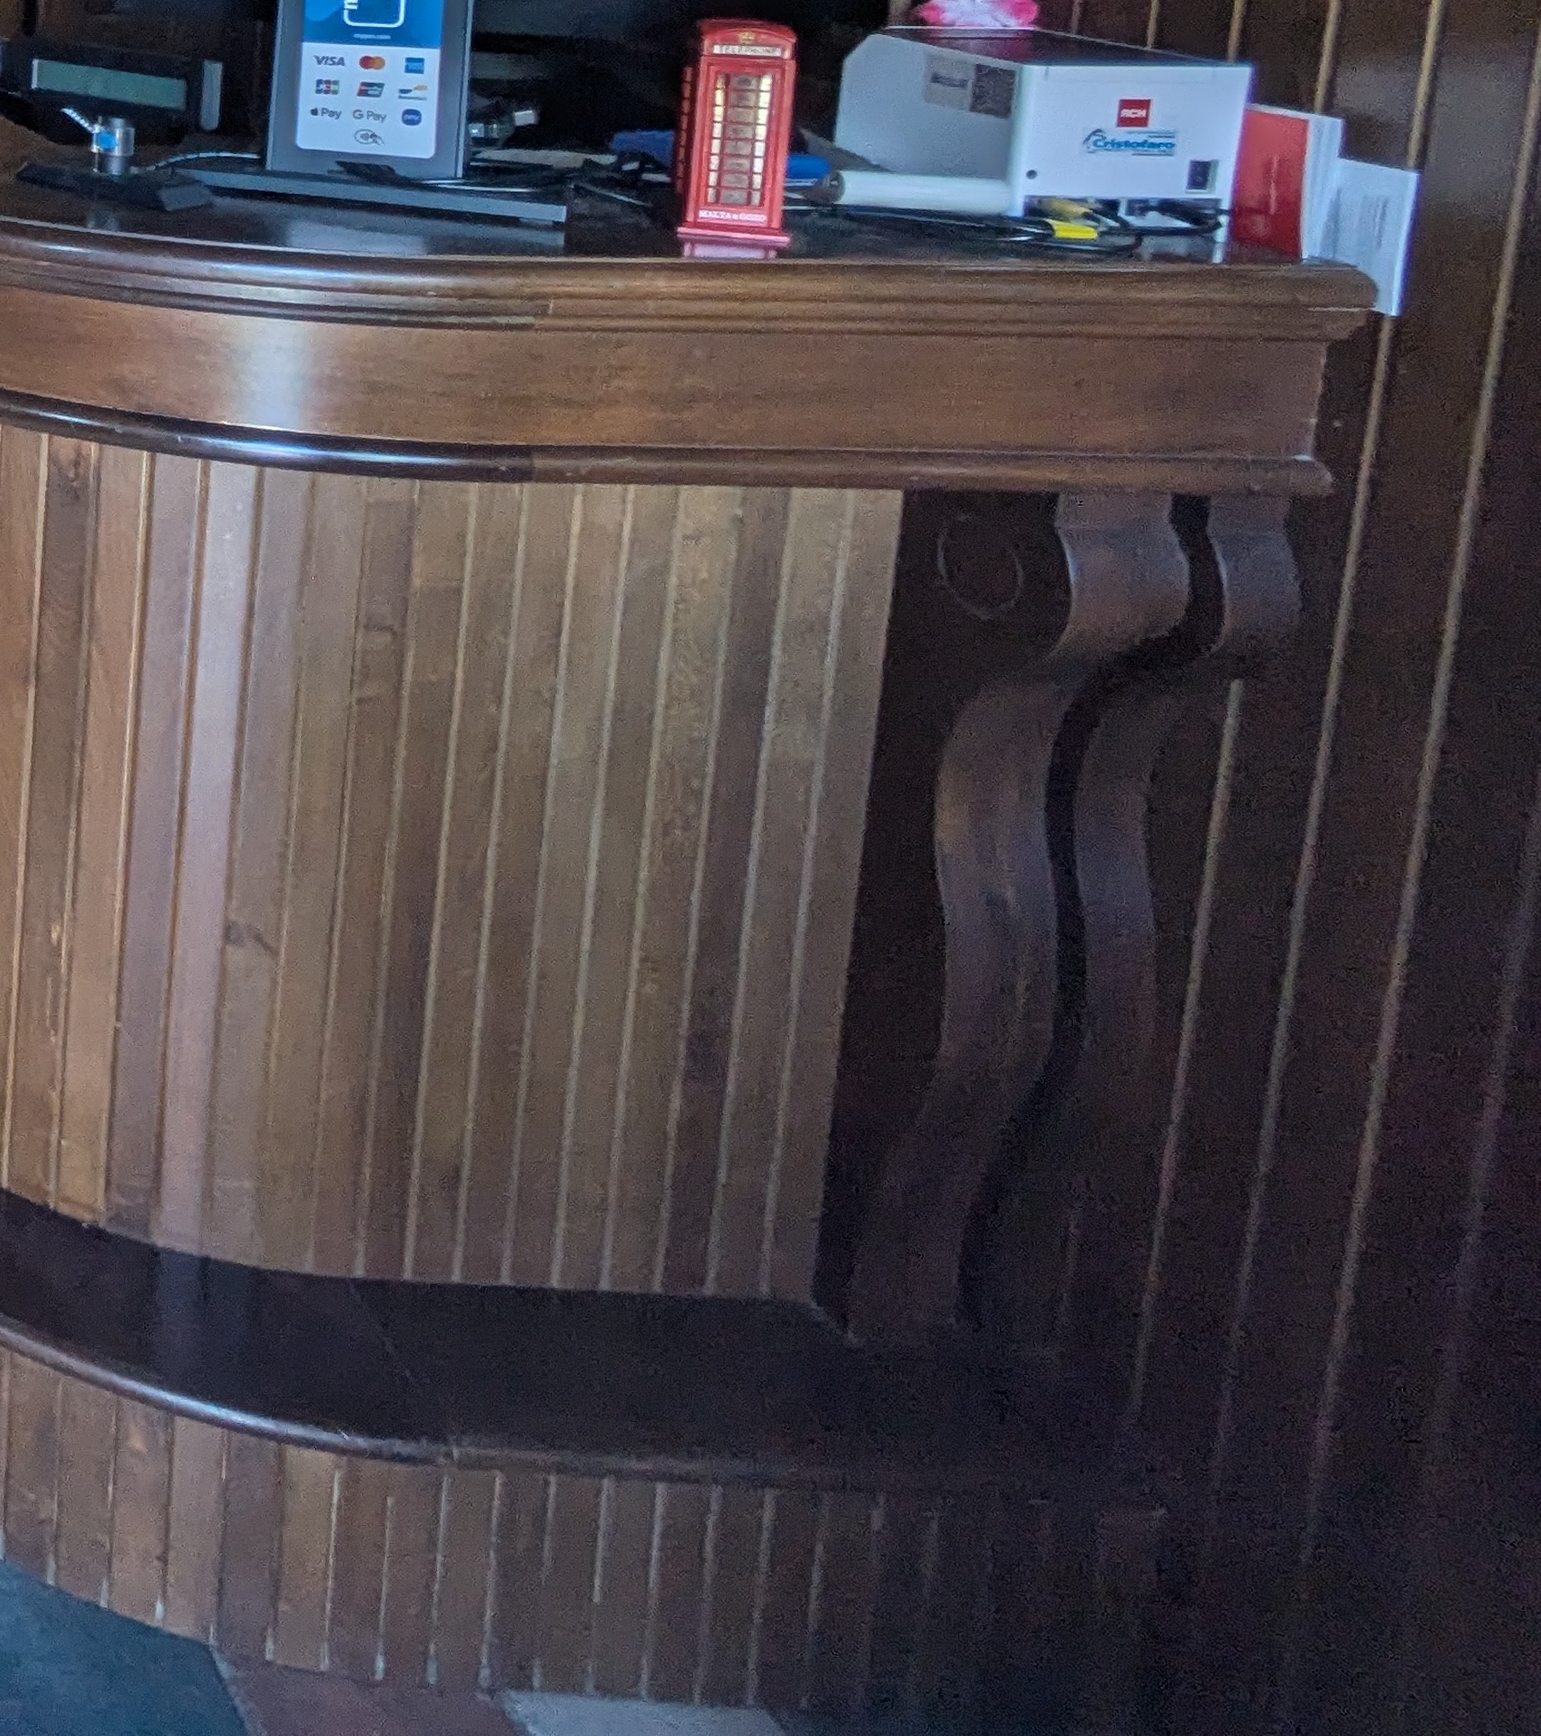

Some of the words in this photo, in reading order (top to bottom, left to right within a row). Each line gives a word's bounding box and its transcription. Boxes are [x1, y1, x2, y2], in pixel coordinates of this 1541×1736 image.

[313, 55, 346, 67] VISA
[320, 107, 342, 120] Pay
[366, 110, 387, 123] Pay
[1091, 137, 1176, 150] Cristofaro
